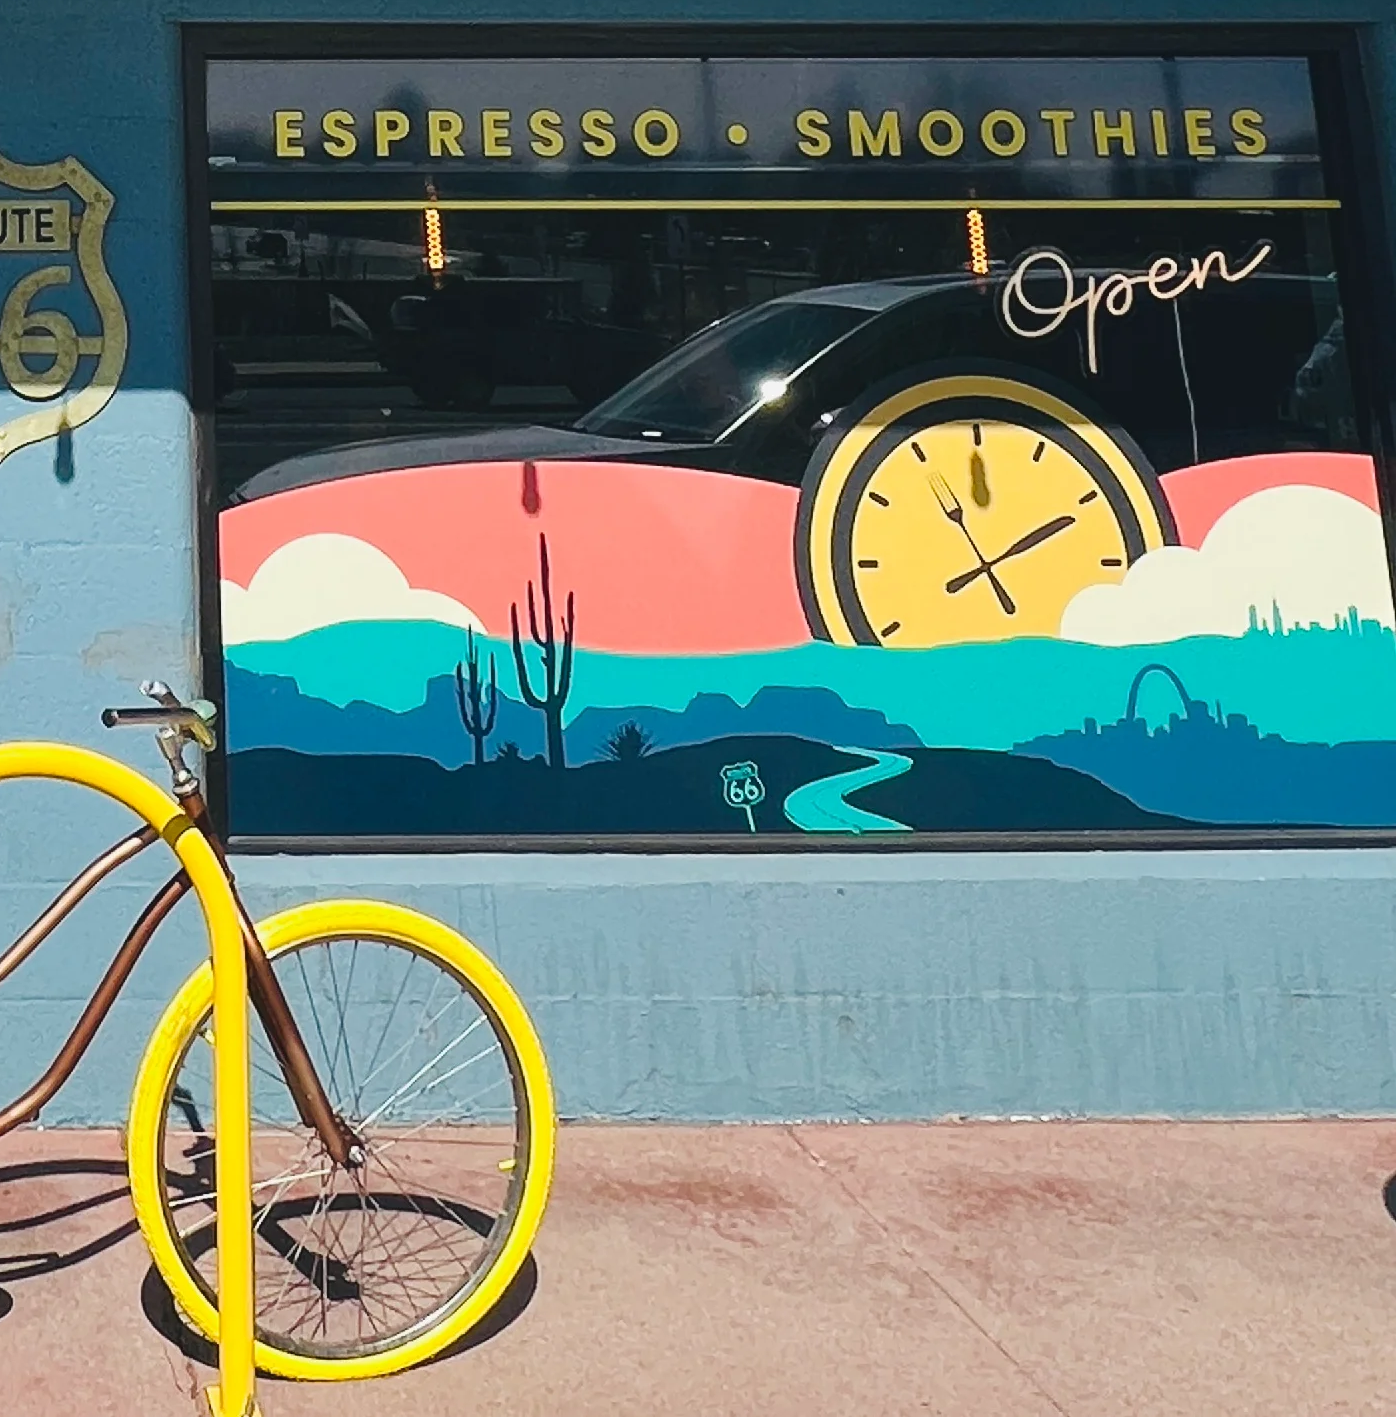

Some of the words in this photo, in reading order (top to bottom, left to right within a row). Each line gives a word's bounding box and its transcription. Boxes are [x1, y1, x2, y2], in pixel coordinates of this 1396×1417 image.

[273, 109, 681, 159] ESPRESSO
[794, 108, 1269, 159] SMOOTHIES
[1000, 243, 1273, 375] Open
[730, 777, 759, 802] 66
